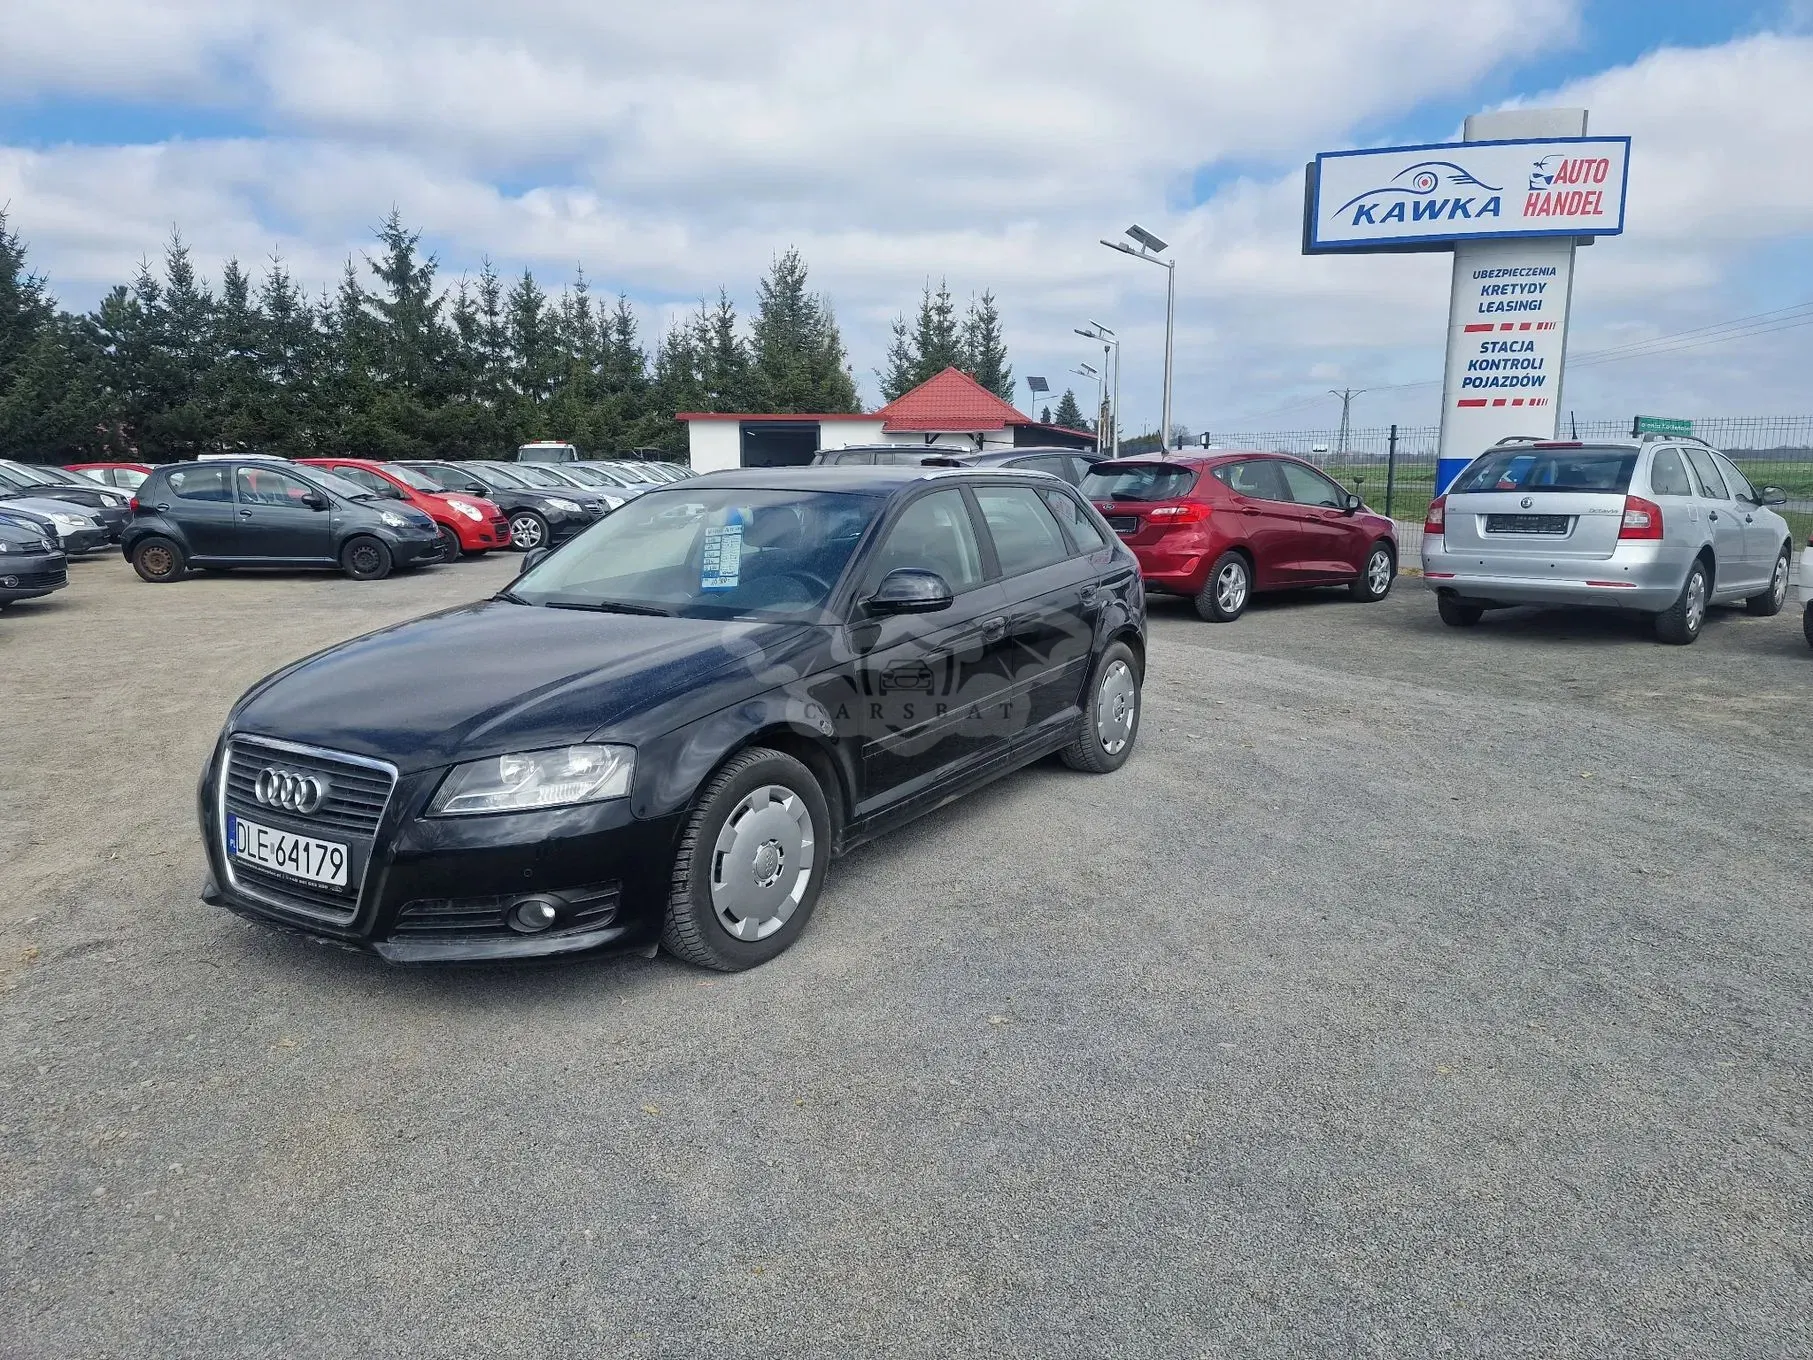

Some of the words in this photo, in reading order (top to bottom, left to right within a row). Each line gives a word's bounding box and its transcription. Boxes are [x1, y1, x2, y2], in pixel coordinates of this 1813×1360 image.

[1553, 158, 1609, 184] AUTO
[1351, 196, 1501, 226] KAWKA
[1523, 191, 1603, 217] HANDEL
[1472, 267, 1557, 280] UBEZPIECZENIA
[1480, 282, 1547, 297] KRETYDY
[1478, 299, 1543, 313] LEASINGI
[1479, 340, 1535, 354] STACJA
[1467, 358, 1544, 372] KONTROLI
[1461, 373, 1547, 389] POJAZDÓW
[237, 821, 269, 862] DLE
[275, 835, 344, 880] 64179
